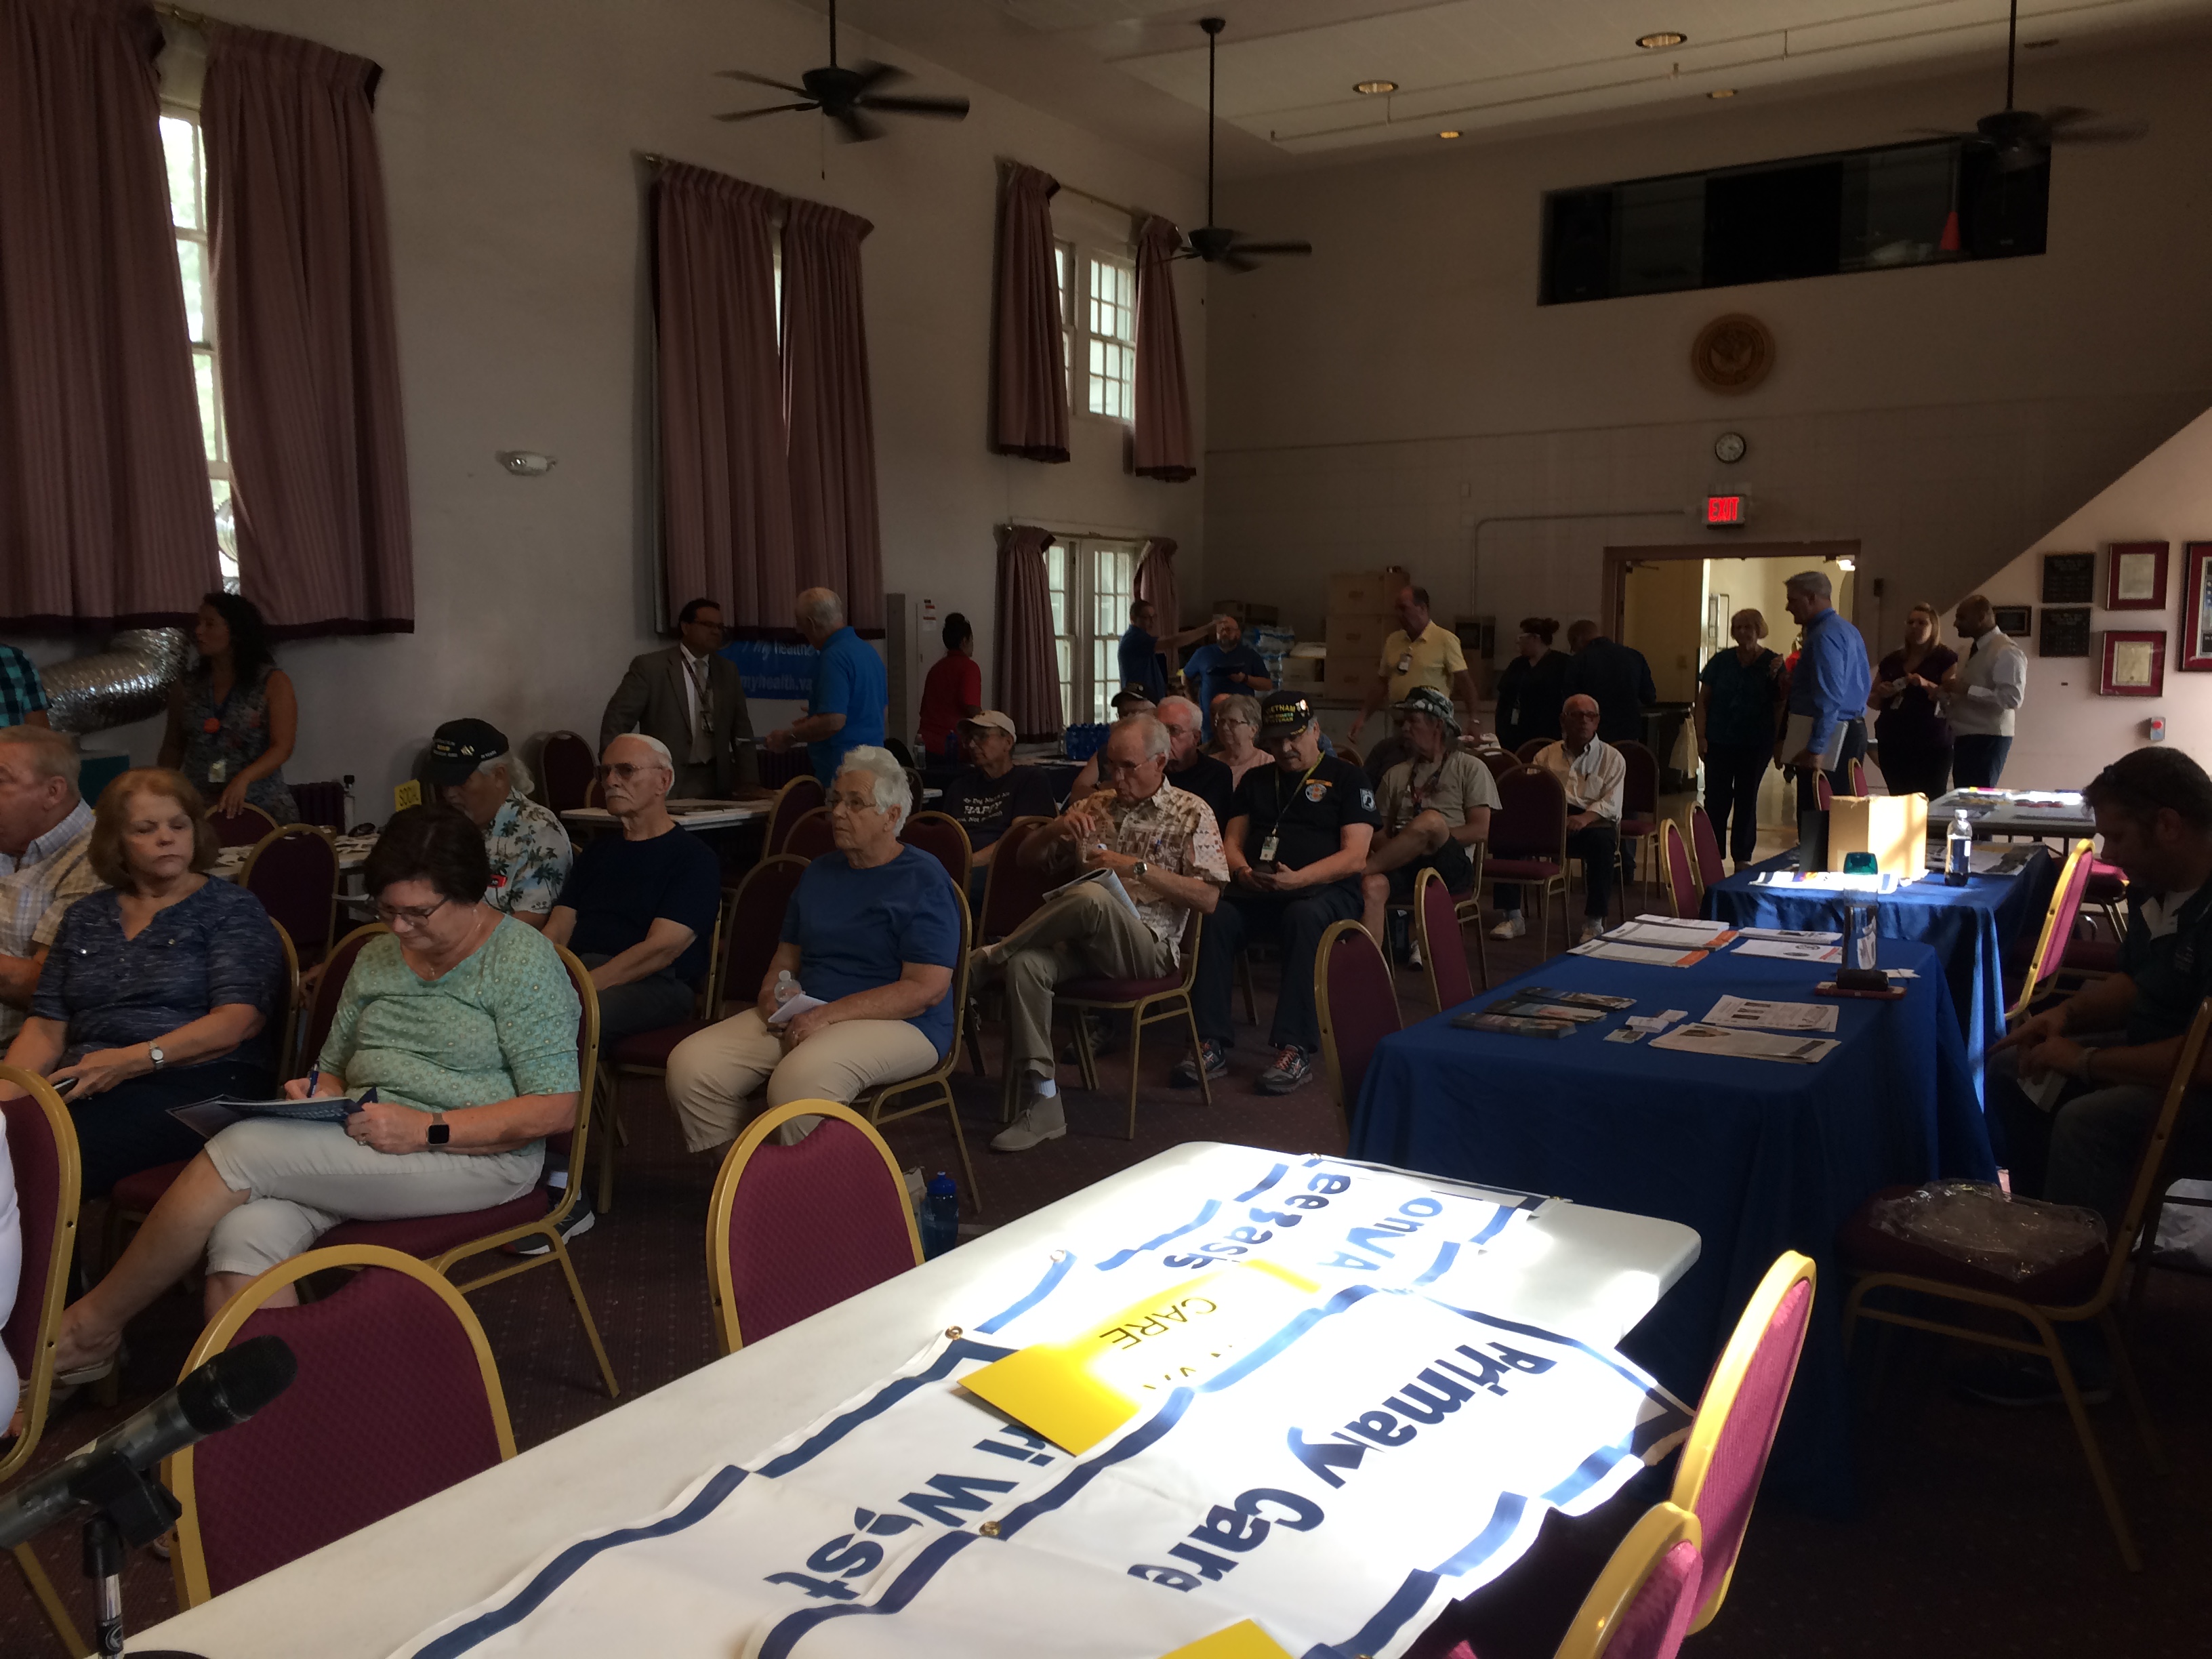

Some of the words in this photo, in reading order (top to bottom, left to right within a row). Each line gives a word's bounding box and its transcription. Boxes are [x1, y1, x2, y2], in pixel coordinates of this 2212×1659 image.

[1708, 496, 1740, 522] EXIT
[1099, 1297, 1218, 1350] CARE
[1287, 1339, 1557, 1491] Primary
[1126, 1487, 1324, 1594] Care
